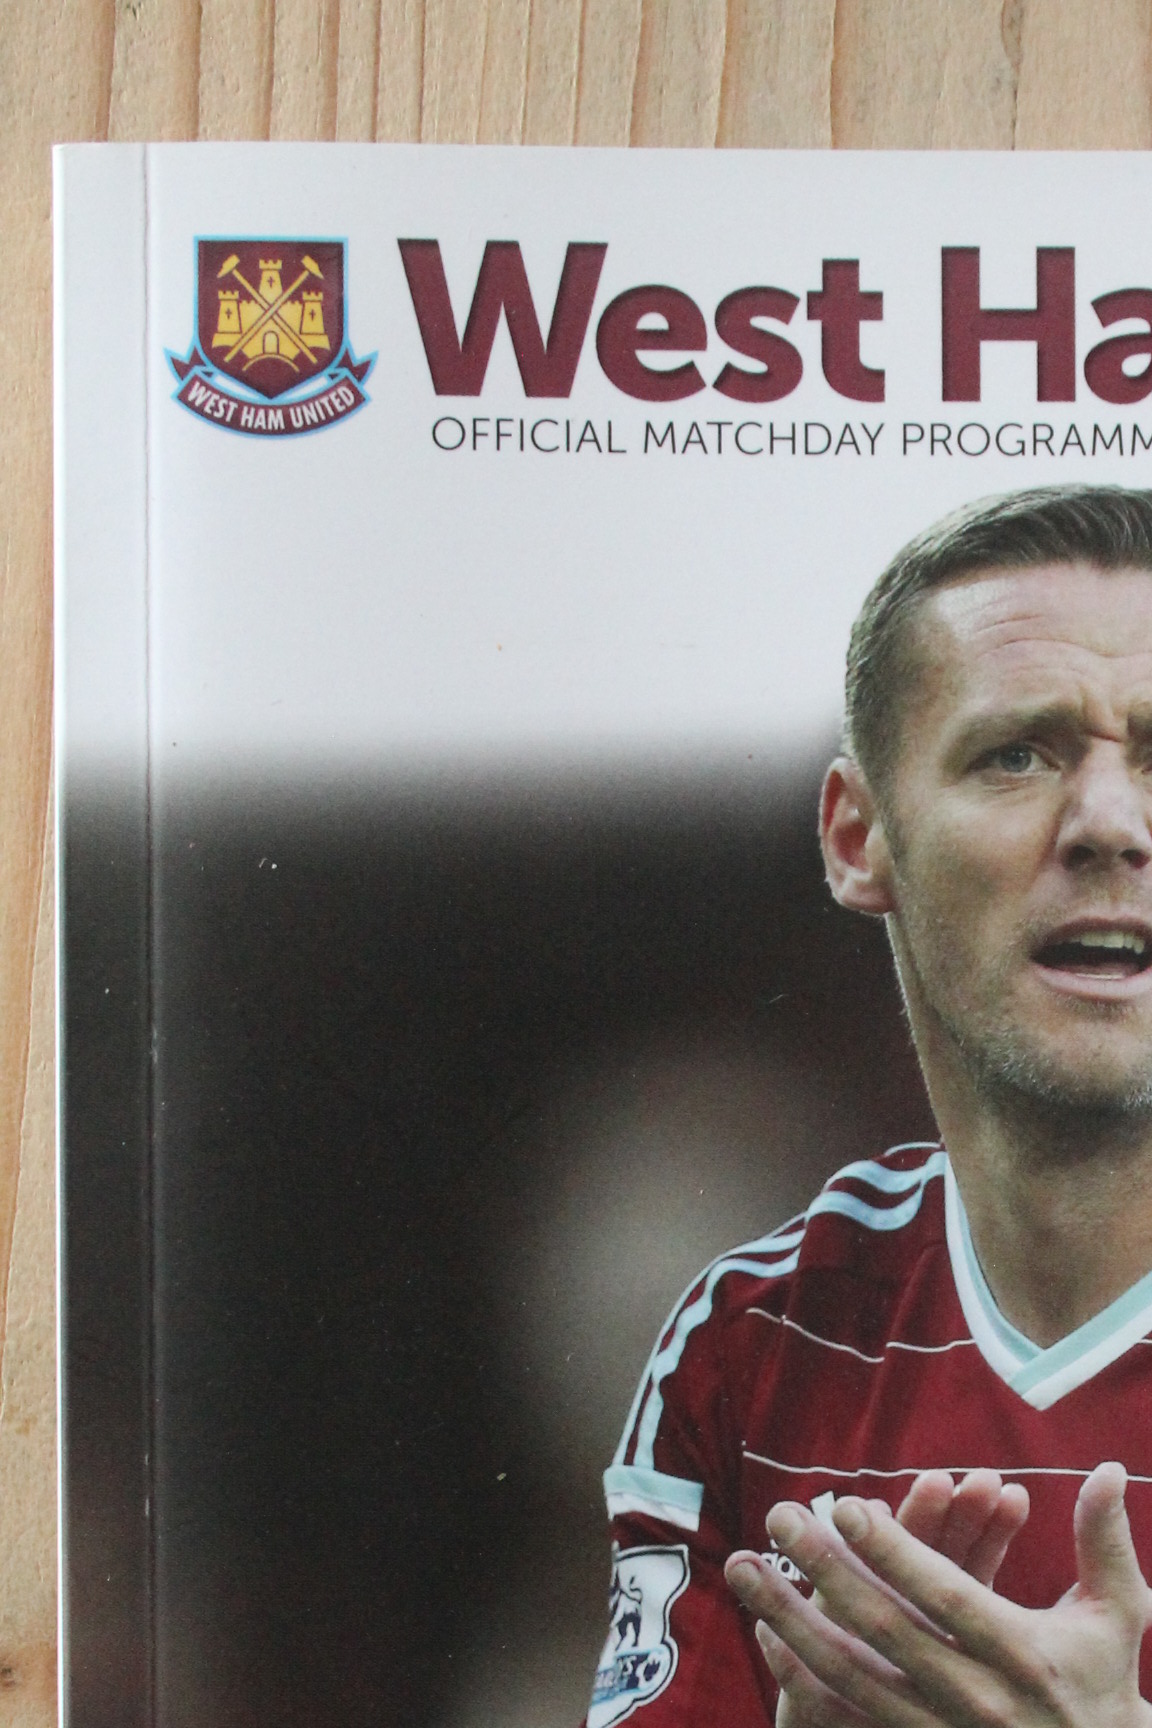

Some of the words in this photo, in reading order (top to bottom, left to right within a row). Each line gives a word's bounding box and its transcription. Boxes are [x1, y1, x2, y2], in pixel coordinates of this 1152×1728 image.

[397, 237, 885, 404] West
[187, 381, 238, 422] WEST
[241, 408, 285, 430] HAM
[289, 385, 355, 428] UNITED
[431, 417, 626, 455] OFFICIAL
[643, 421, 884, 456] MATCHDAY
